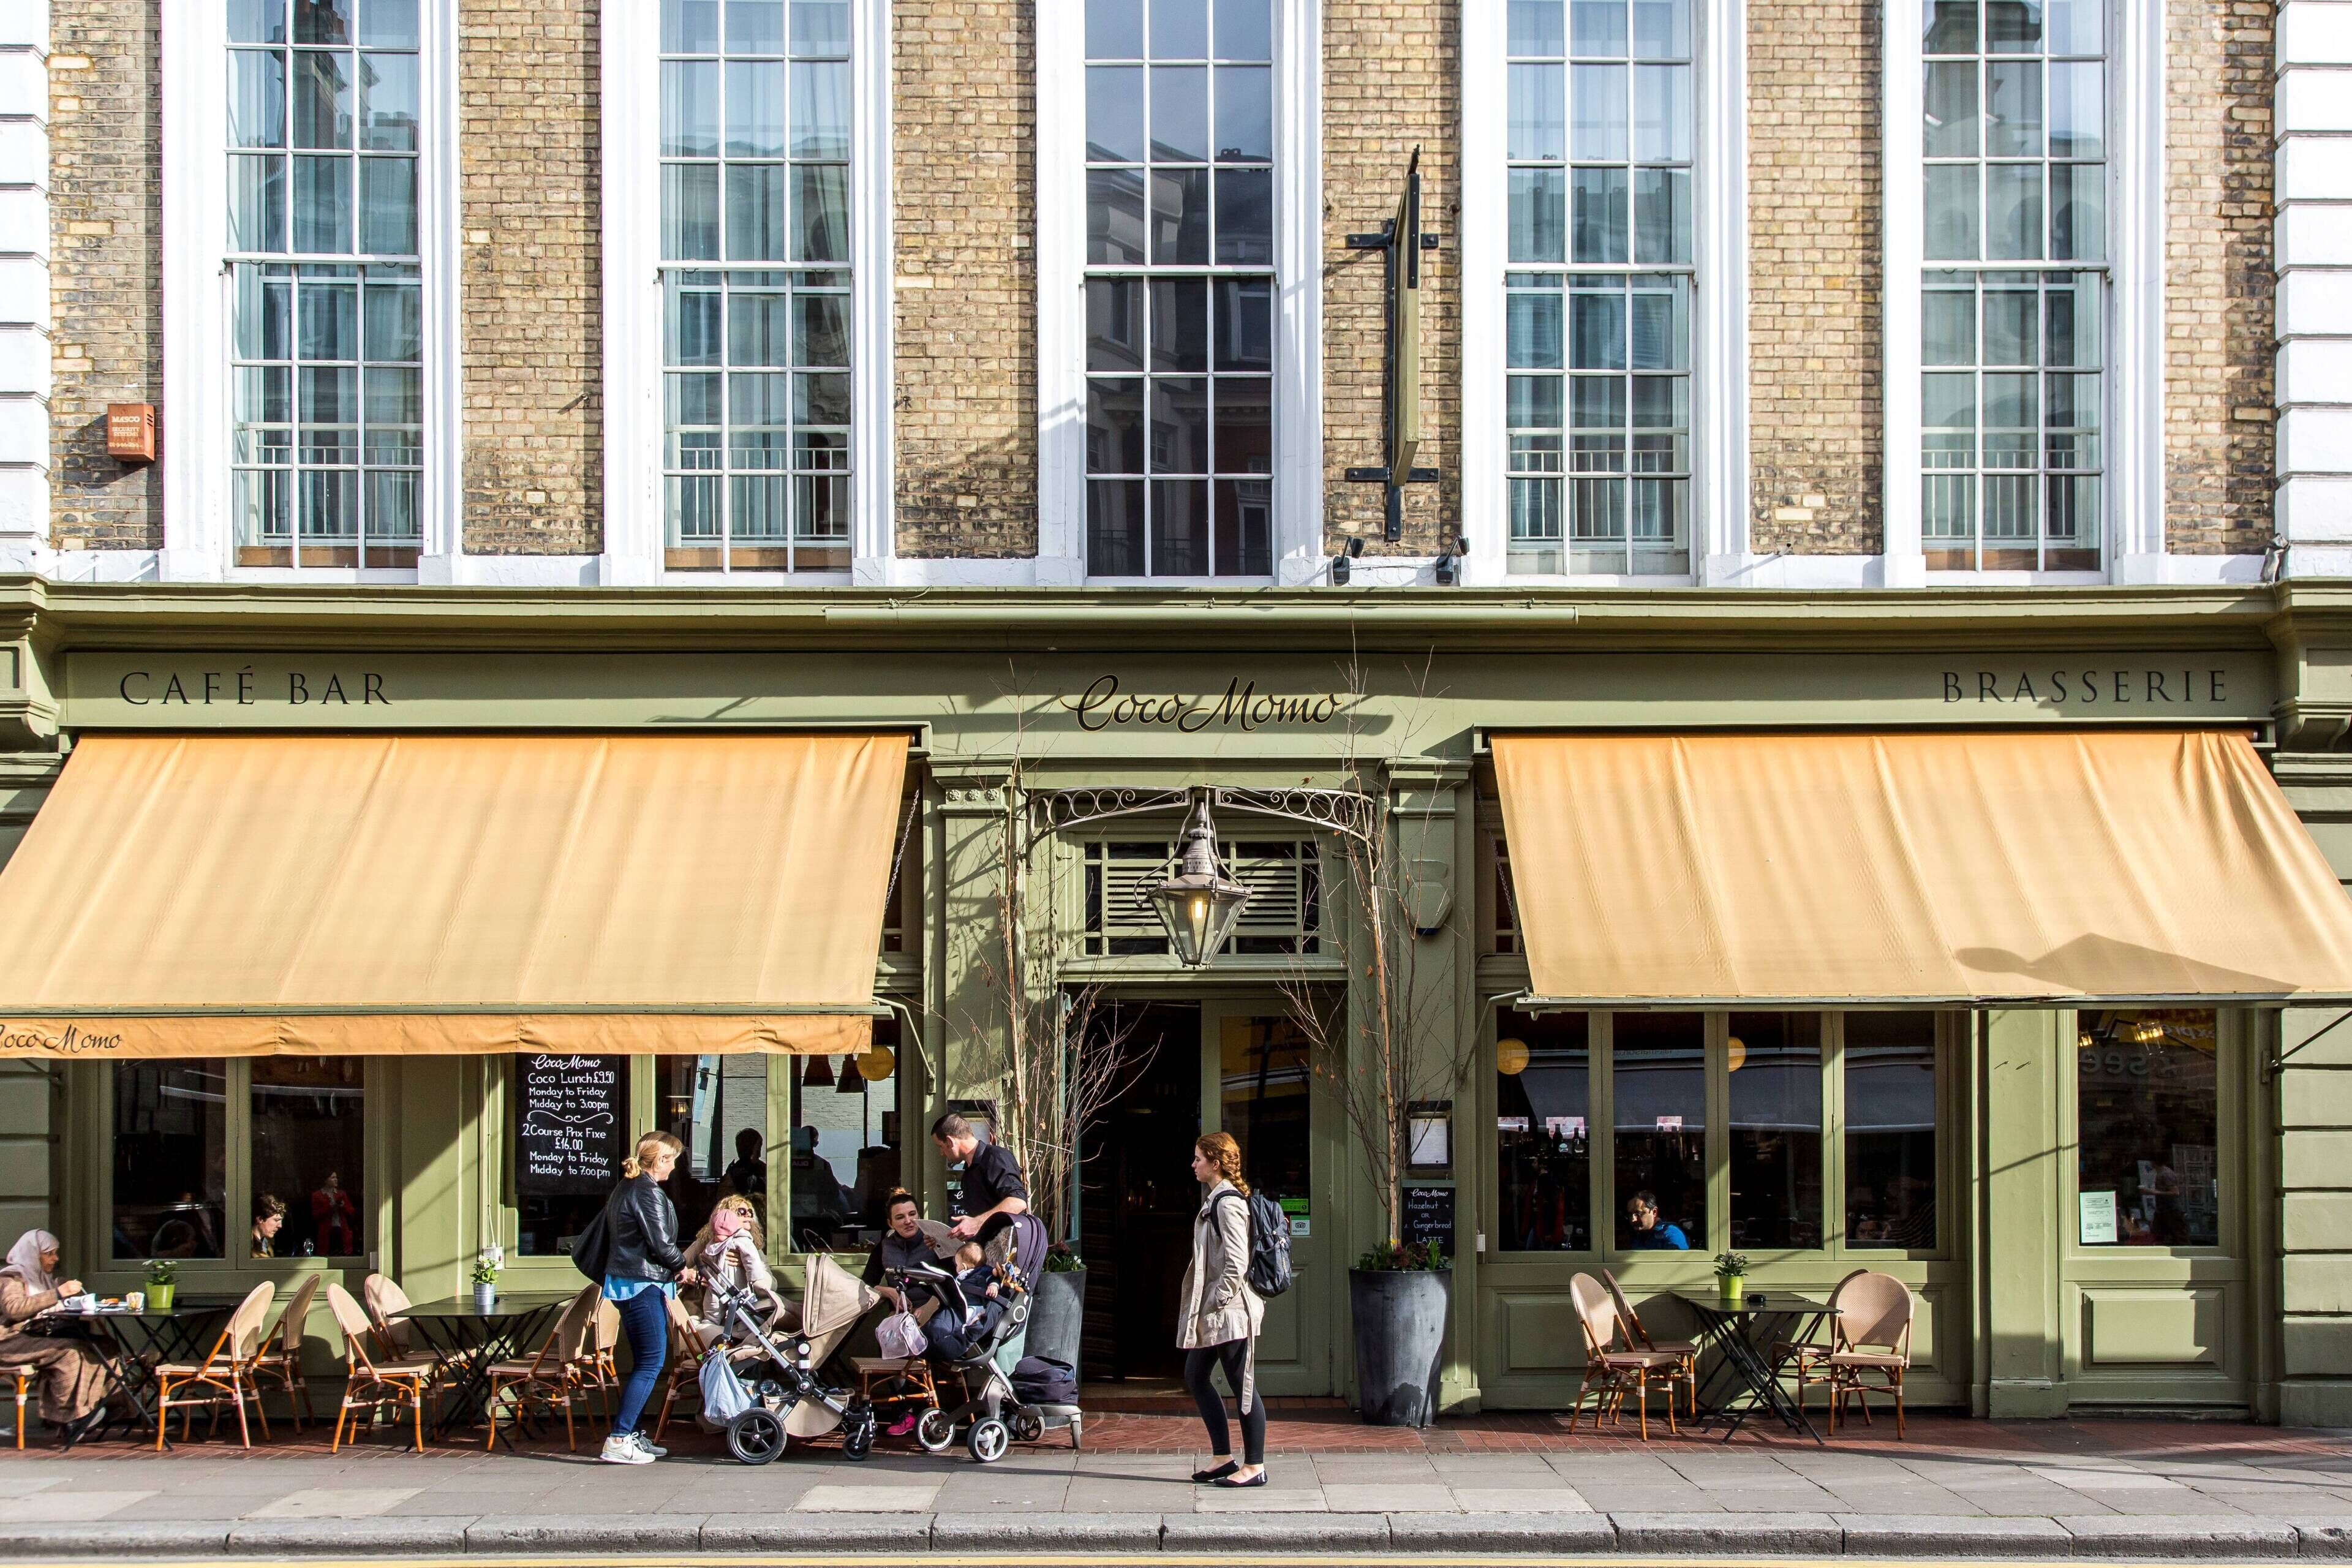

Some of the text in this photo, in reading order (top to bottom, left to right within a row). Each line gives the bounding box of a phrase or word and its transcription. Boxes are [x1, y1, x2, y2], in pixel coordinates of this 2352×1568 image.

[119, 665, 393, 706] CAFÉ BAR
[1941, 669, 2228, 703] BRASSERIE
[1060, 673, 1344, 734] Coco Momo
[43, 1023, 123, 1054] Momo
[531, 1054, 601, 1070] Coco Momo
[528, 1072, 556, 1084] Coco
[560, 1072, 592, 1084] Lunch
[529, 1087, 607, 1099] Monday to Friday
[529, 1098, 563, 1111] Midday
[565, 1099, 576, 1108] to
[566, 1126, 582, 1137] Prix
[586, 1128, 606, 1139] Fixe
[554, 1137, 583, 1150] £16.00
[529, 1151, 609, 1166] Monday to Friday
[530, 1164, 564, 1176] Midday
[568, 1165, 578, 1175] to
[1411, 1188, 1449, 1197] Coco Momo
[1408, 1199, 1439, 1209] Hazelnut
[1413, 1219, 1452, 1232] Gingerbread
